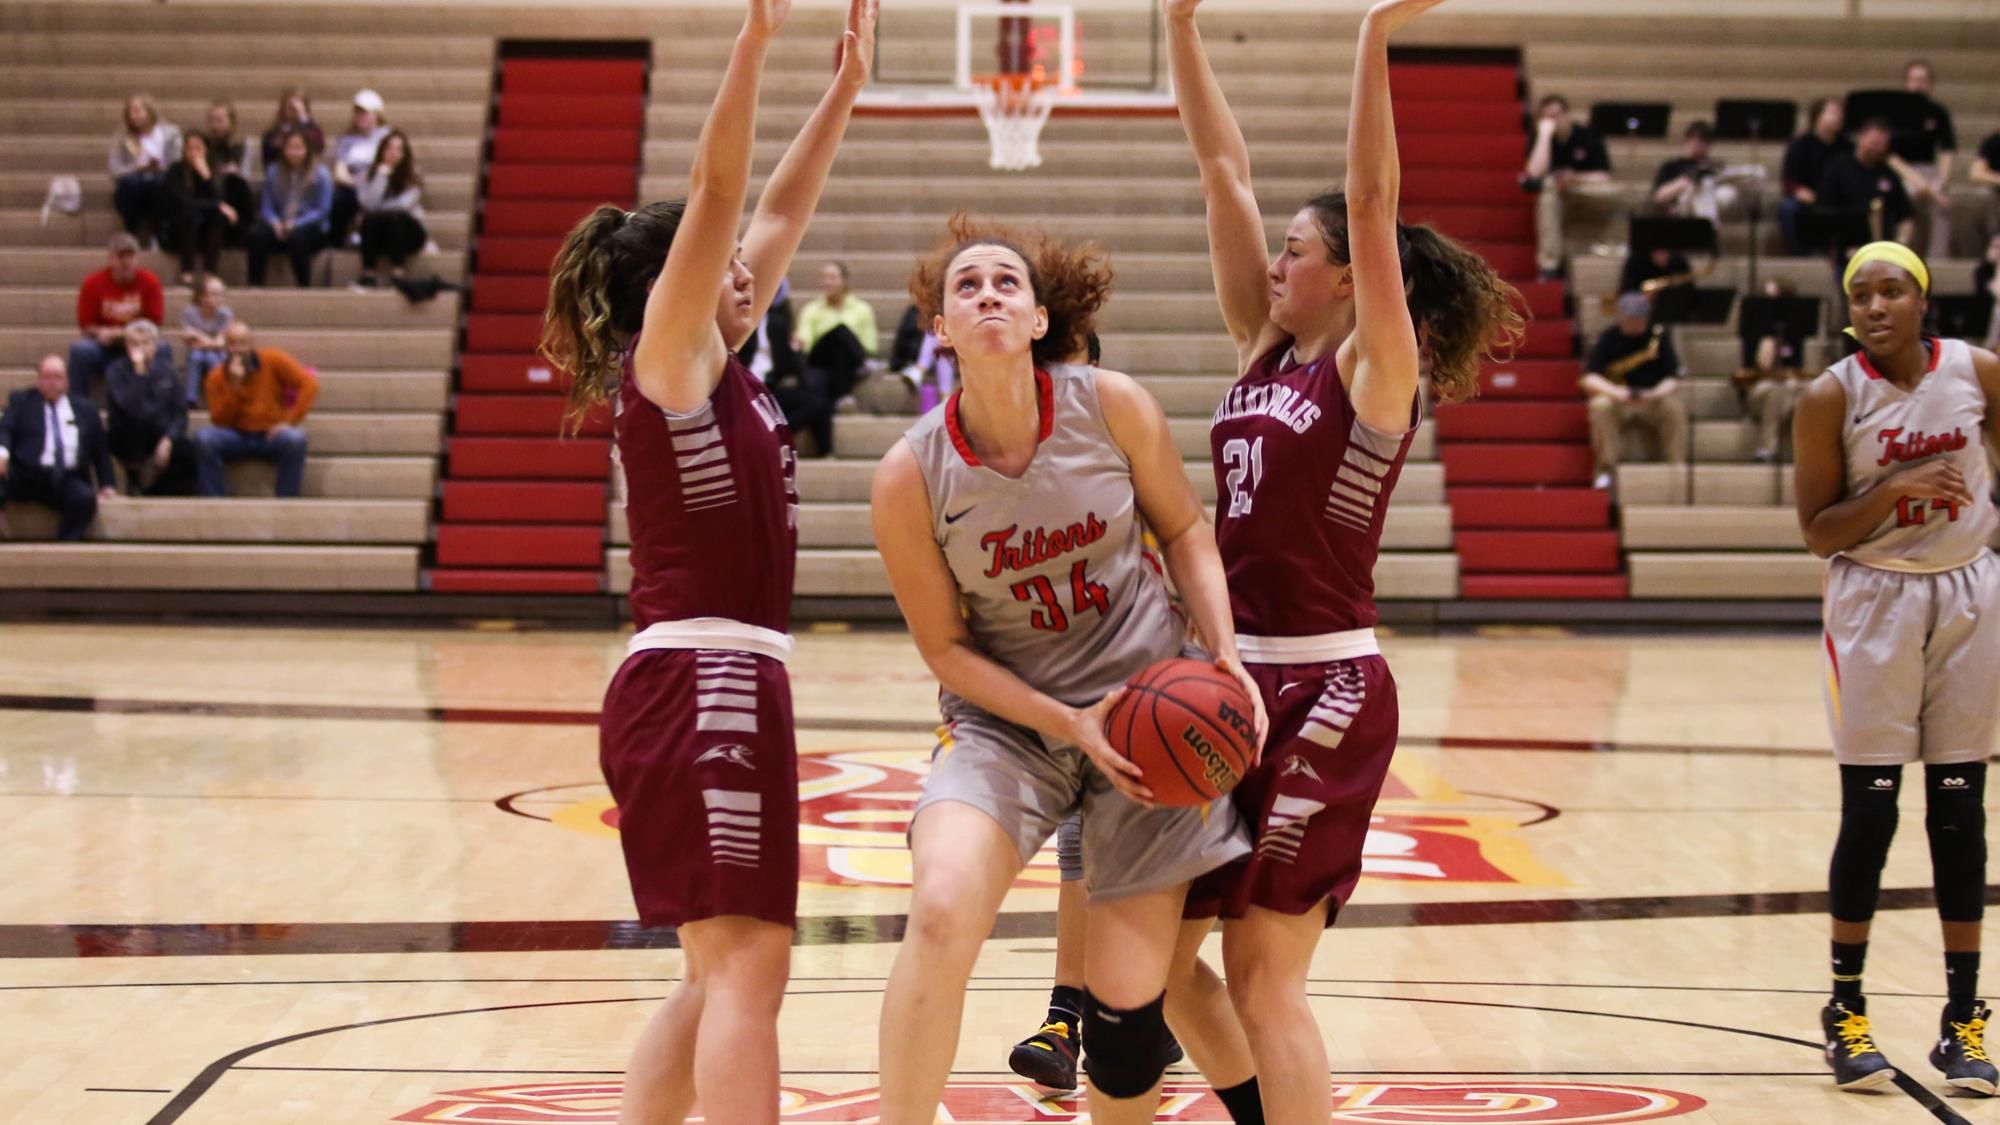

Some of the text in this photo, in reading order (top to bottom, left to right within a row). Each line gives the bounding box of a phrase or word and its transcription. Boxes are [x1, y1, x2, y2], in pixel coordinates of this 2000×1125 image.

[1223, 436, 1263, 518] 21
[980, 511, 1107, 578] Tritons
[1009, 558, 1110, 633] 34
